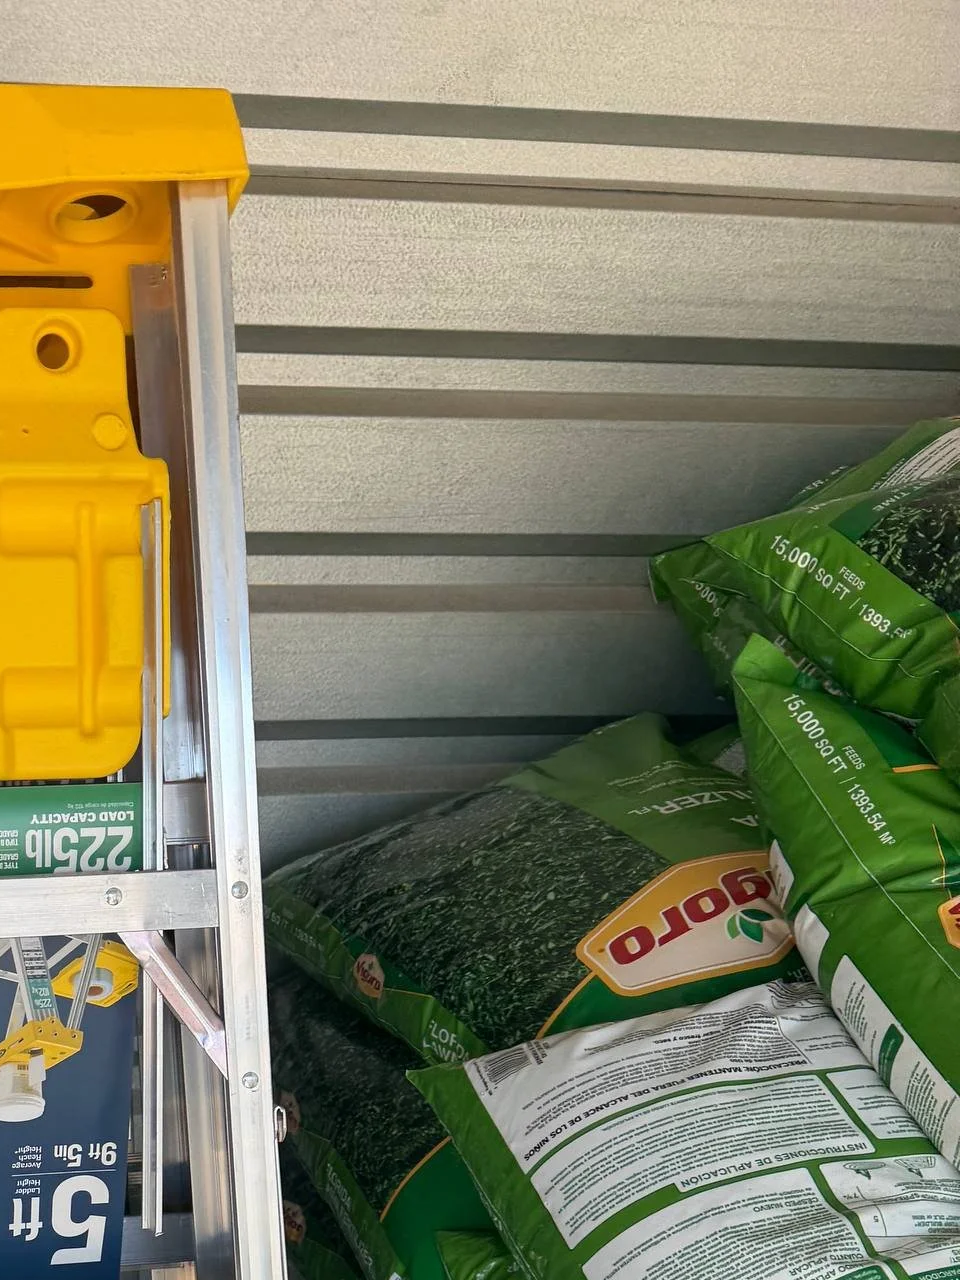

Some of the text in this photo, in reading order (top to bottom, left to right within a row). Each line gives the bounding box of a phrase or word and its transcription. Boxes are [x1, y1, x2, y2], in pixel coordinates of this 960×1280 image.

[770, 535, 851, 600] 15,000 SQ FT
[838, 566, 866, 591] FEEDS
[783, 694, 887, 831] 15,000 SQ FT 1393.54
[842, 745, 866, 770] FEEDS
[30, 810, 135, 824] LOAD CAPACITY
[25, 825, 133, 874] 225lb
[523, 1066, 743, 1162] MANTENER FUERA DEL ALCANCE DE LOS NIÑOS
[11, 1159, 43, 1170] Average
[18, 1153, 42, 1162] Reach
[54, 1142, 83, 1168] 5in
[680, 1142, 868, 1190] INSTRUCCIONES DE APLICACIÓN
[14, 1186, 41, 1196] Ladder
[16, 1177, 41, 1188] Height
[8, 1174, 110, 1265] 5 ft
[752, 1202, 783, 1213] NUEVO
